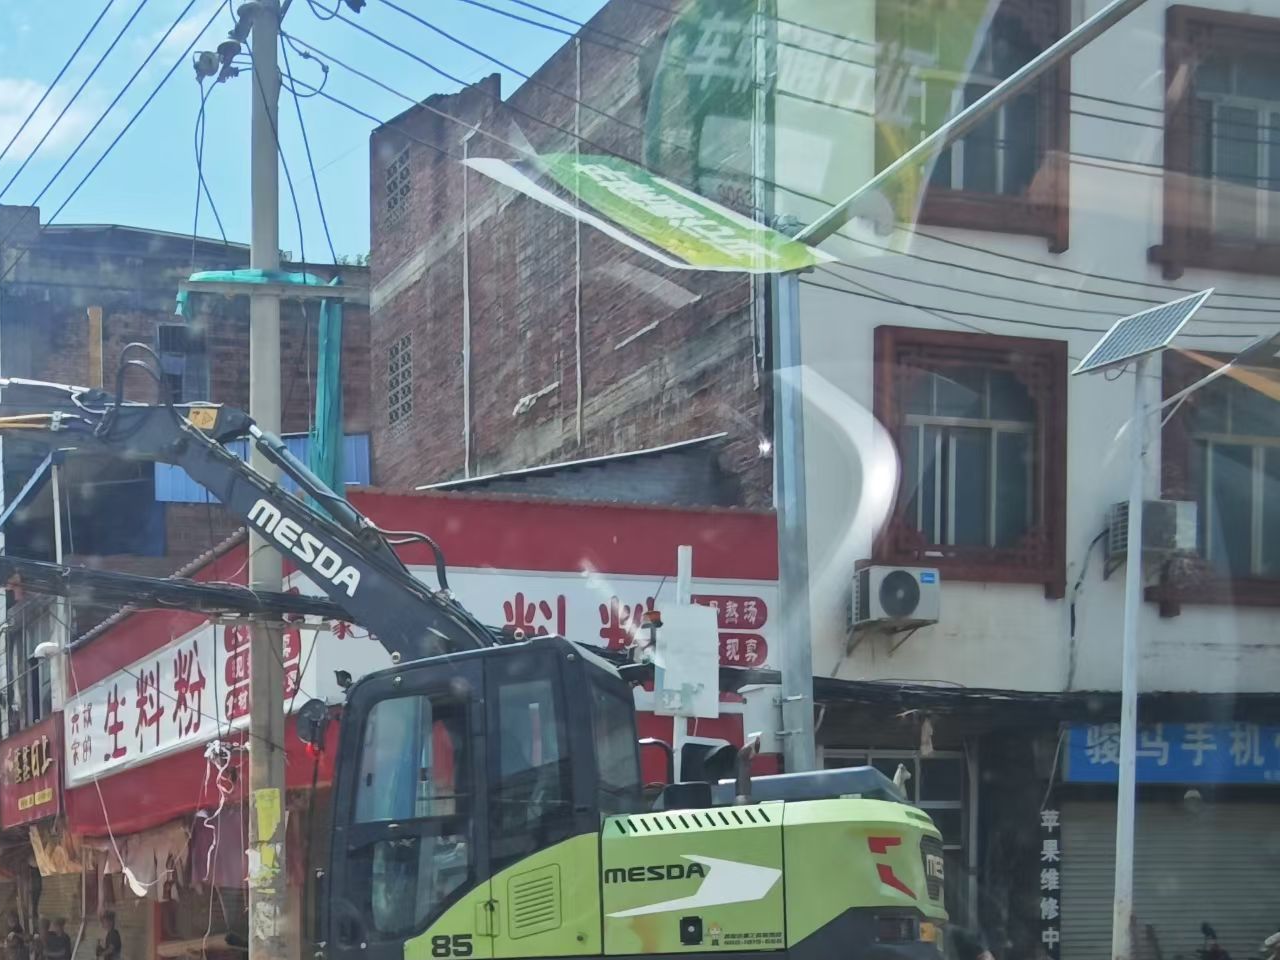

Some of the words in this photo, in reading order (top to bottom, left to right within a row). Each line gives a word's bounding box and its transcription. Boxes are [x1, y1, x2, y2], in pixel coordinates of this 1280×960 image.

[247, 498, 361, 598] MESDA
[104, 639, 207, 762] 生料粉
[1084, 722, 1280, 767] 骏马手机
[604, 862, 706, 884] MESDA
[431, 934, 473, 958] 85
